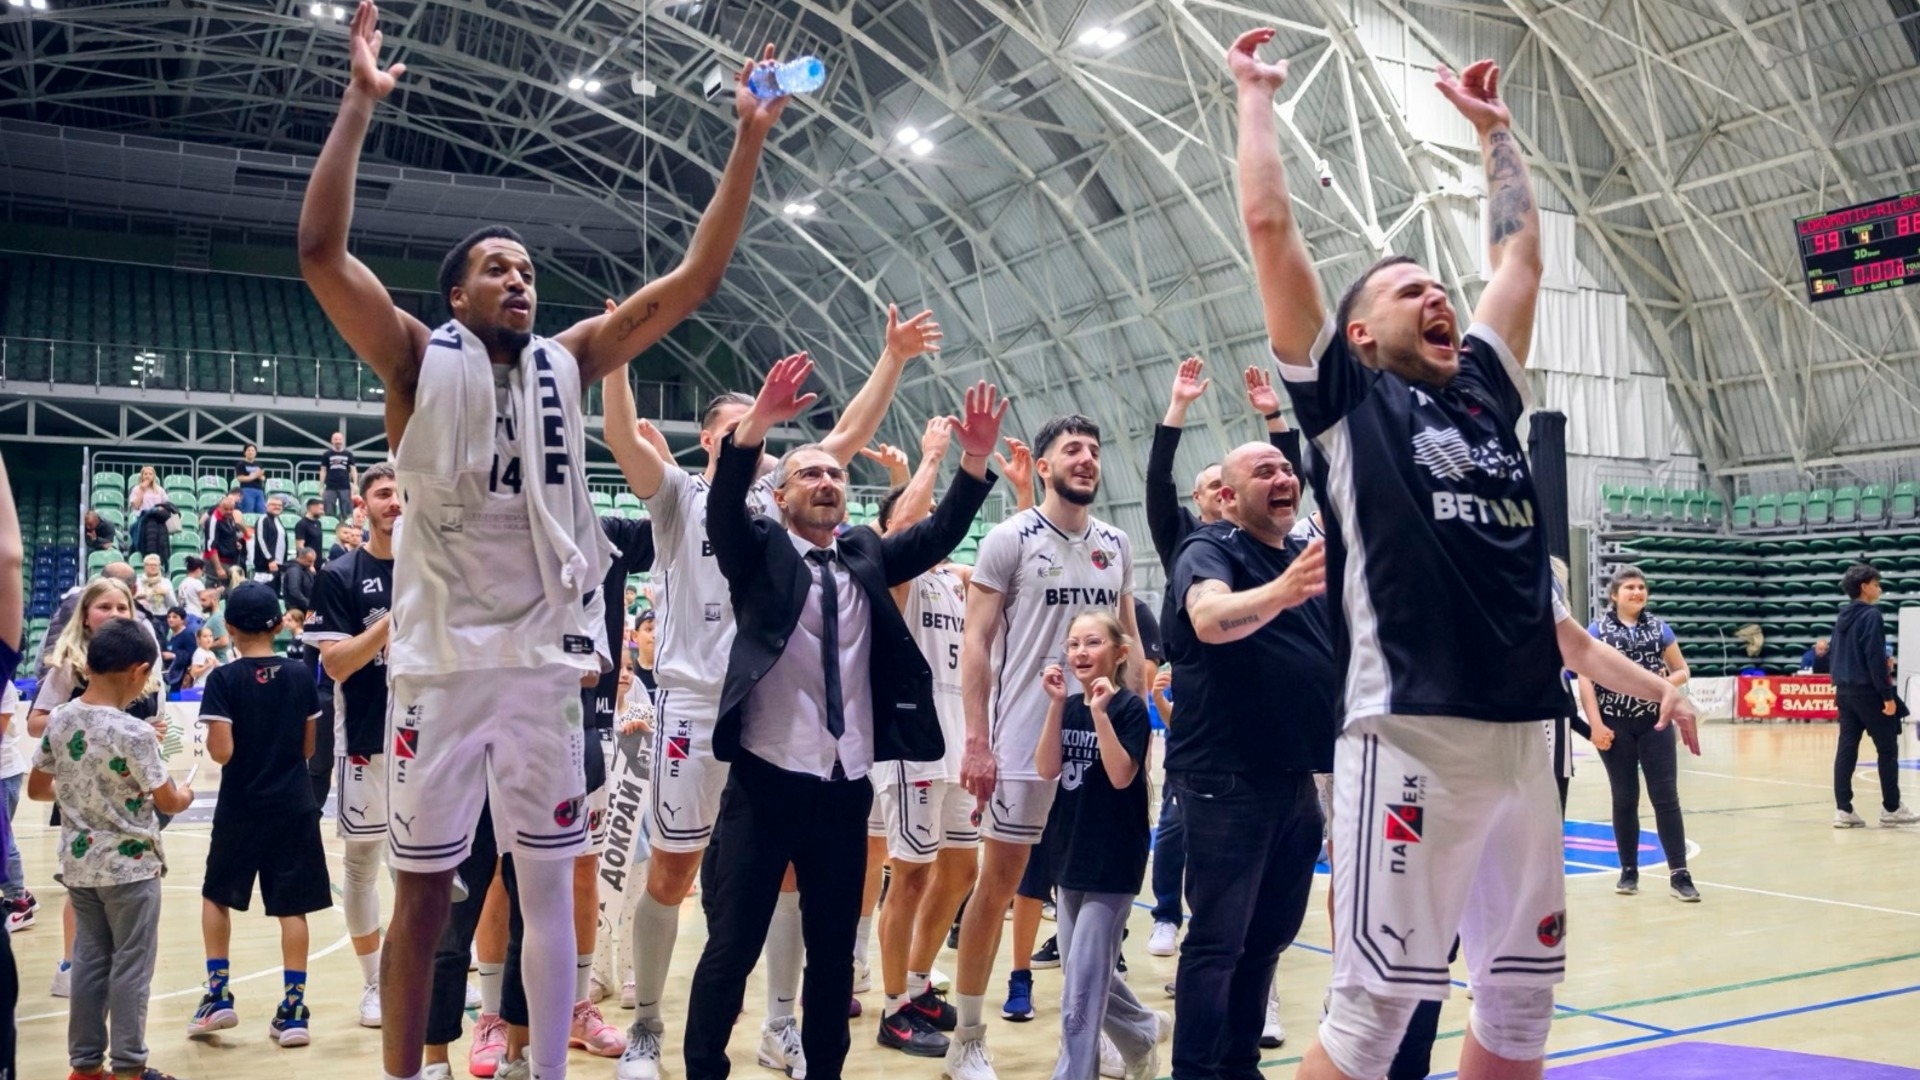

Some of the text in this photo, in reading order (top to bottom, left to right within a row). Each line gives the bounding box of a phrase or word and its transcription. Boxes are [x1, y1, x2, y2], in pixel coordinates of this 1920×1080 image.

[1814, 230, 1839, 255] 99
[1814, 280, 1823, 293] 5
[489, 453, 522, 494] 14
[362, 577, 384, 594] 21
[948, 644, 959, 670] 5
[1782, 698, 1839, 711] ЗЛАТИ
[600, 779, 643, 892] ДОКРАЙ
